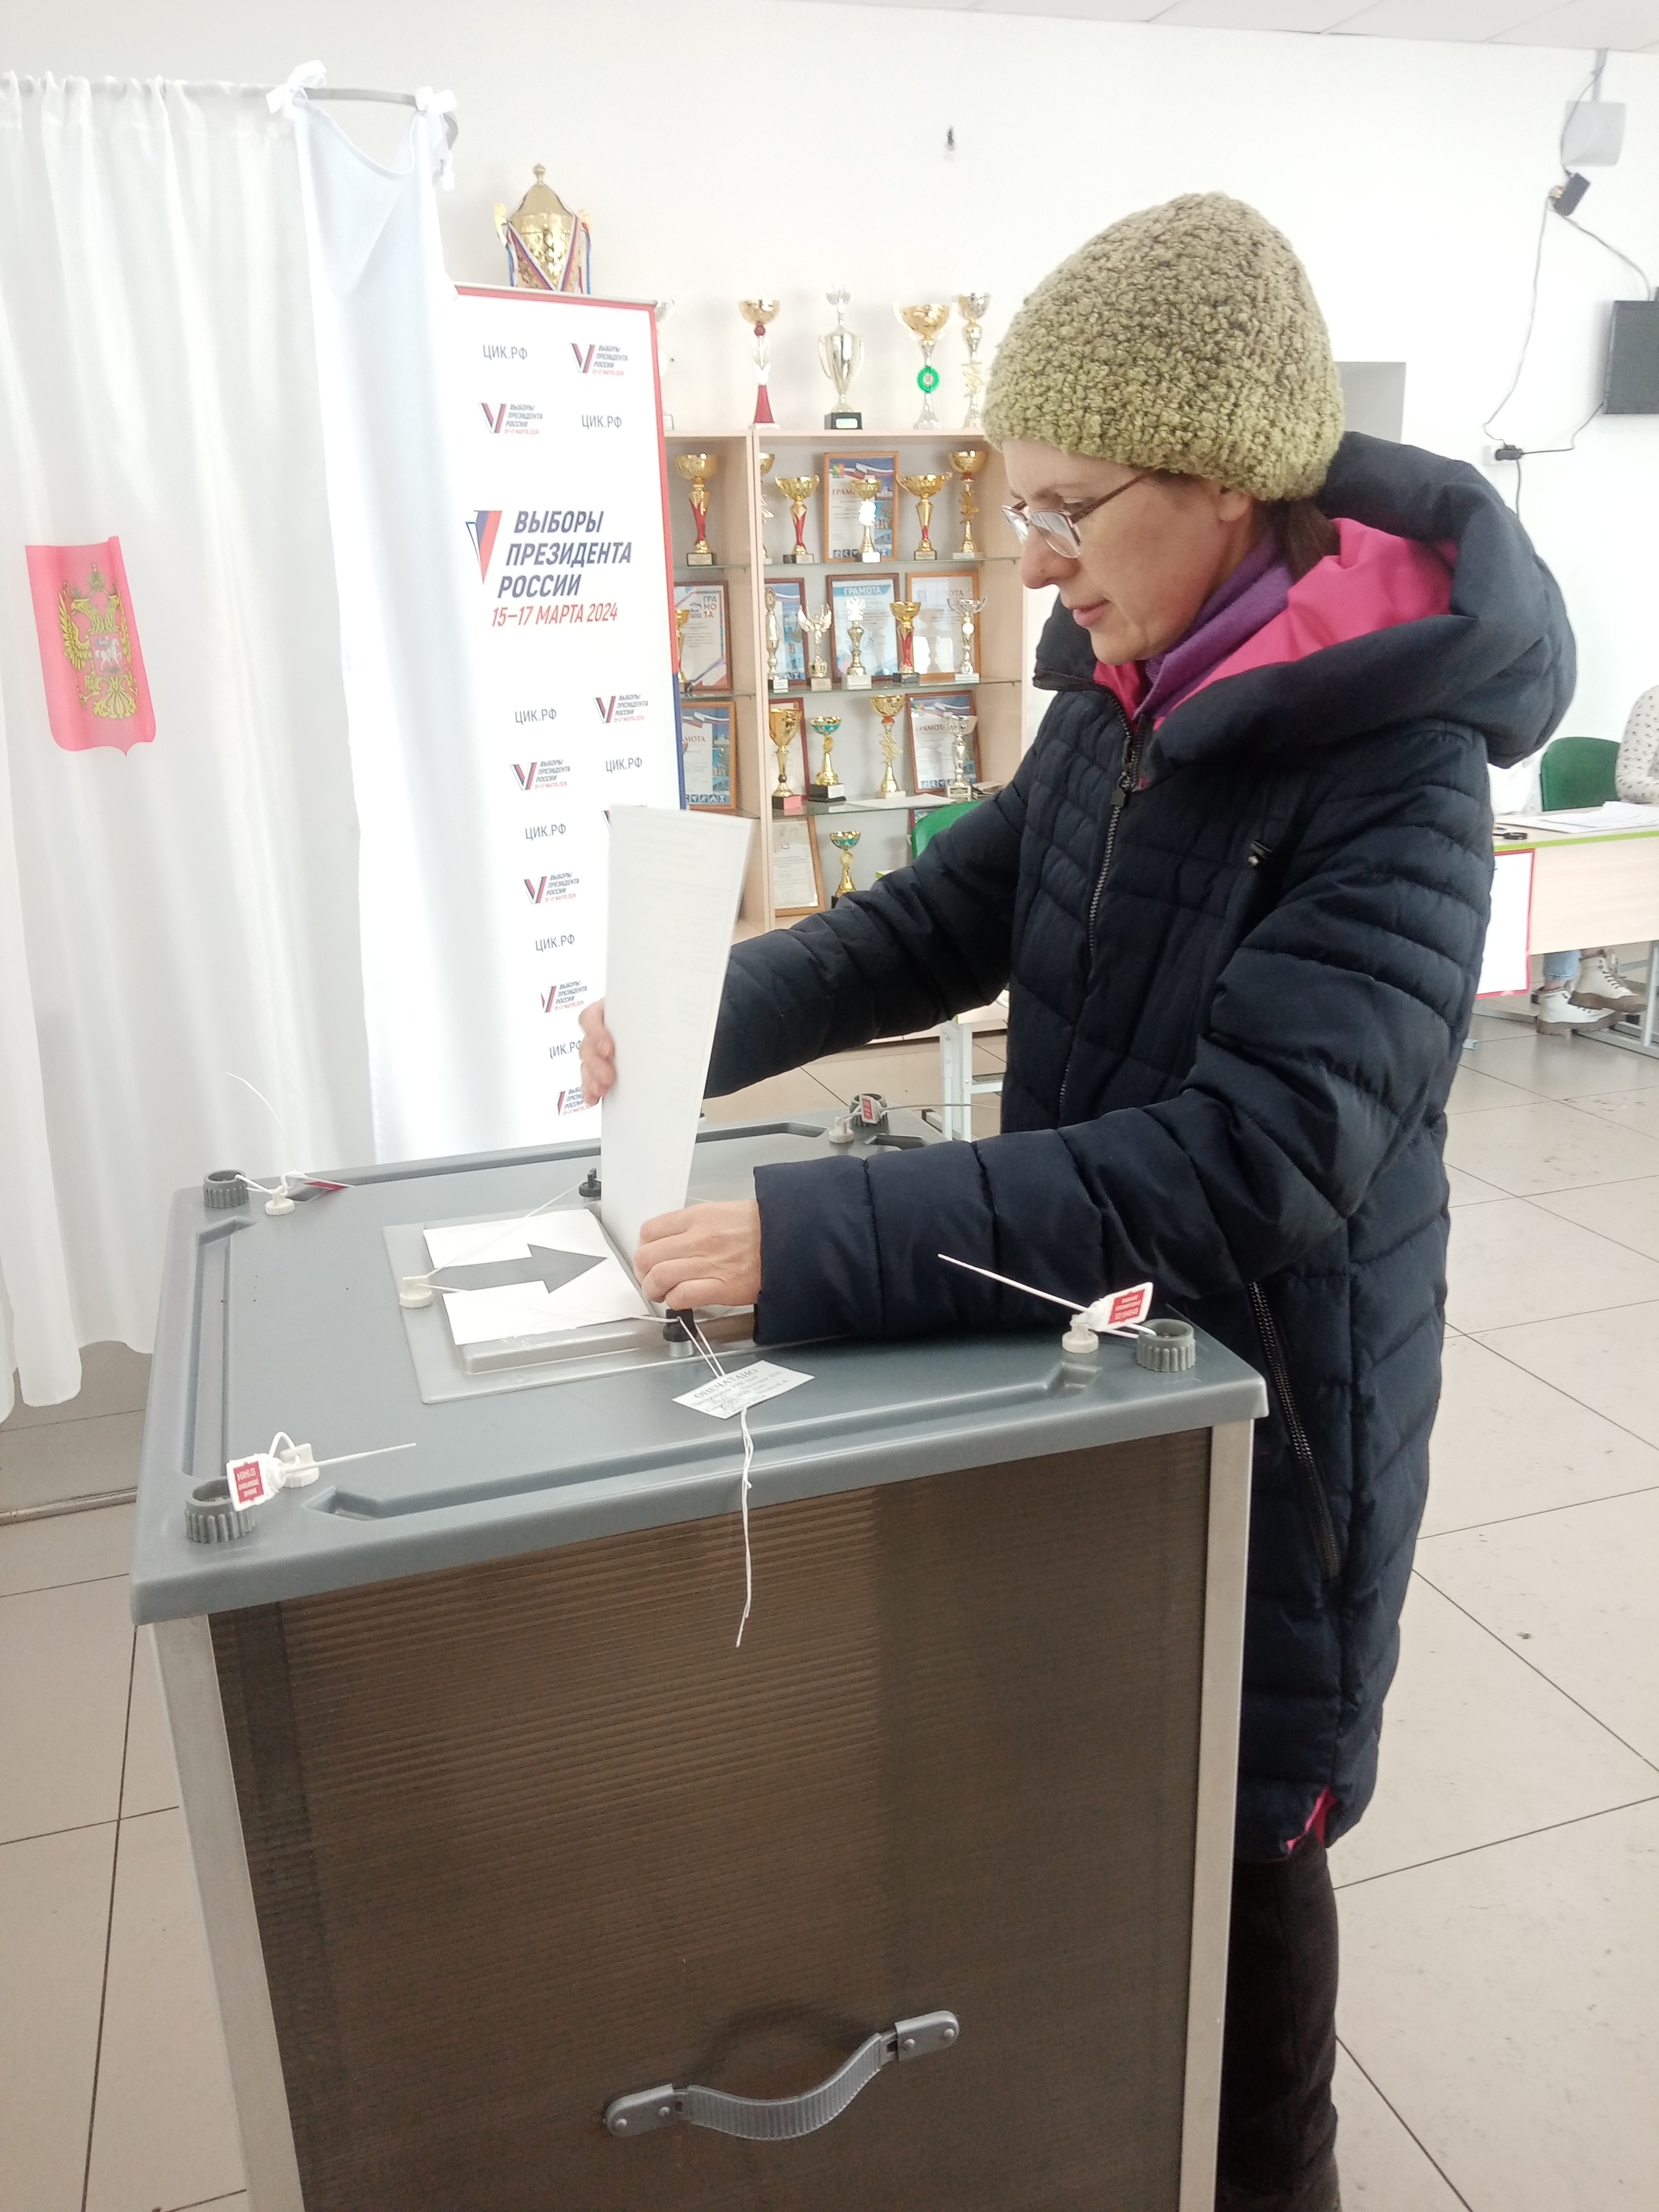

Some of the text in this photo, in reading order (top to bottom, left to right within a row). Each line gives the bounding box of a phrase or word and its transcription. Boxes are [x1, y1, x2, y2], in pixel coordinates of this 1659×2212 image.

[482, 345, 527, 360] ЦИК.РФ
[581, 415, 622, 430] ЦИК.РФ
[514, 510, 604, 533] ВЫБОРЫ
[506, 541, 632, 568] ПРЕЗИДЕНТА
[497, 574, 582, 598] РОССИИ
[844, 586, 882, 596] ГРАМОТА
[535, 604, 583, 625] МАРТА
[586, 602, 618, 623] 2024
[515, 708, 557, 725] ЦИК.РФ
[606, 757, 642, 773] ЦИК.РФ
[525, 823, 566, 841] ЦИК.РФ
[535, 933, 575, 952] ЦИК.РФ
[694, 1368, 759, 1398] ОПЕЧАТАНО
